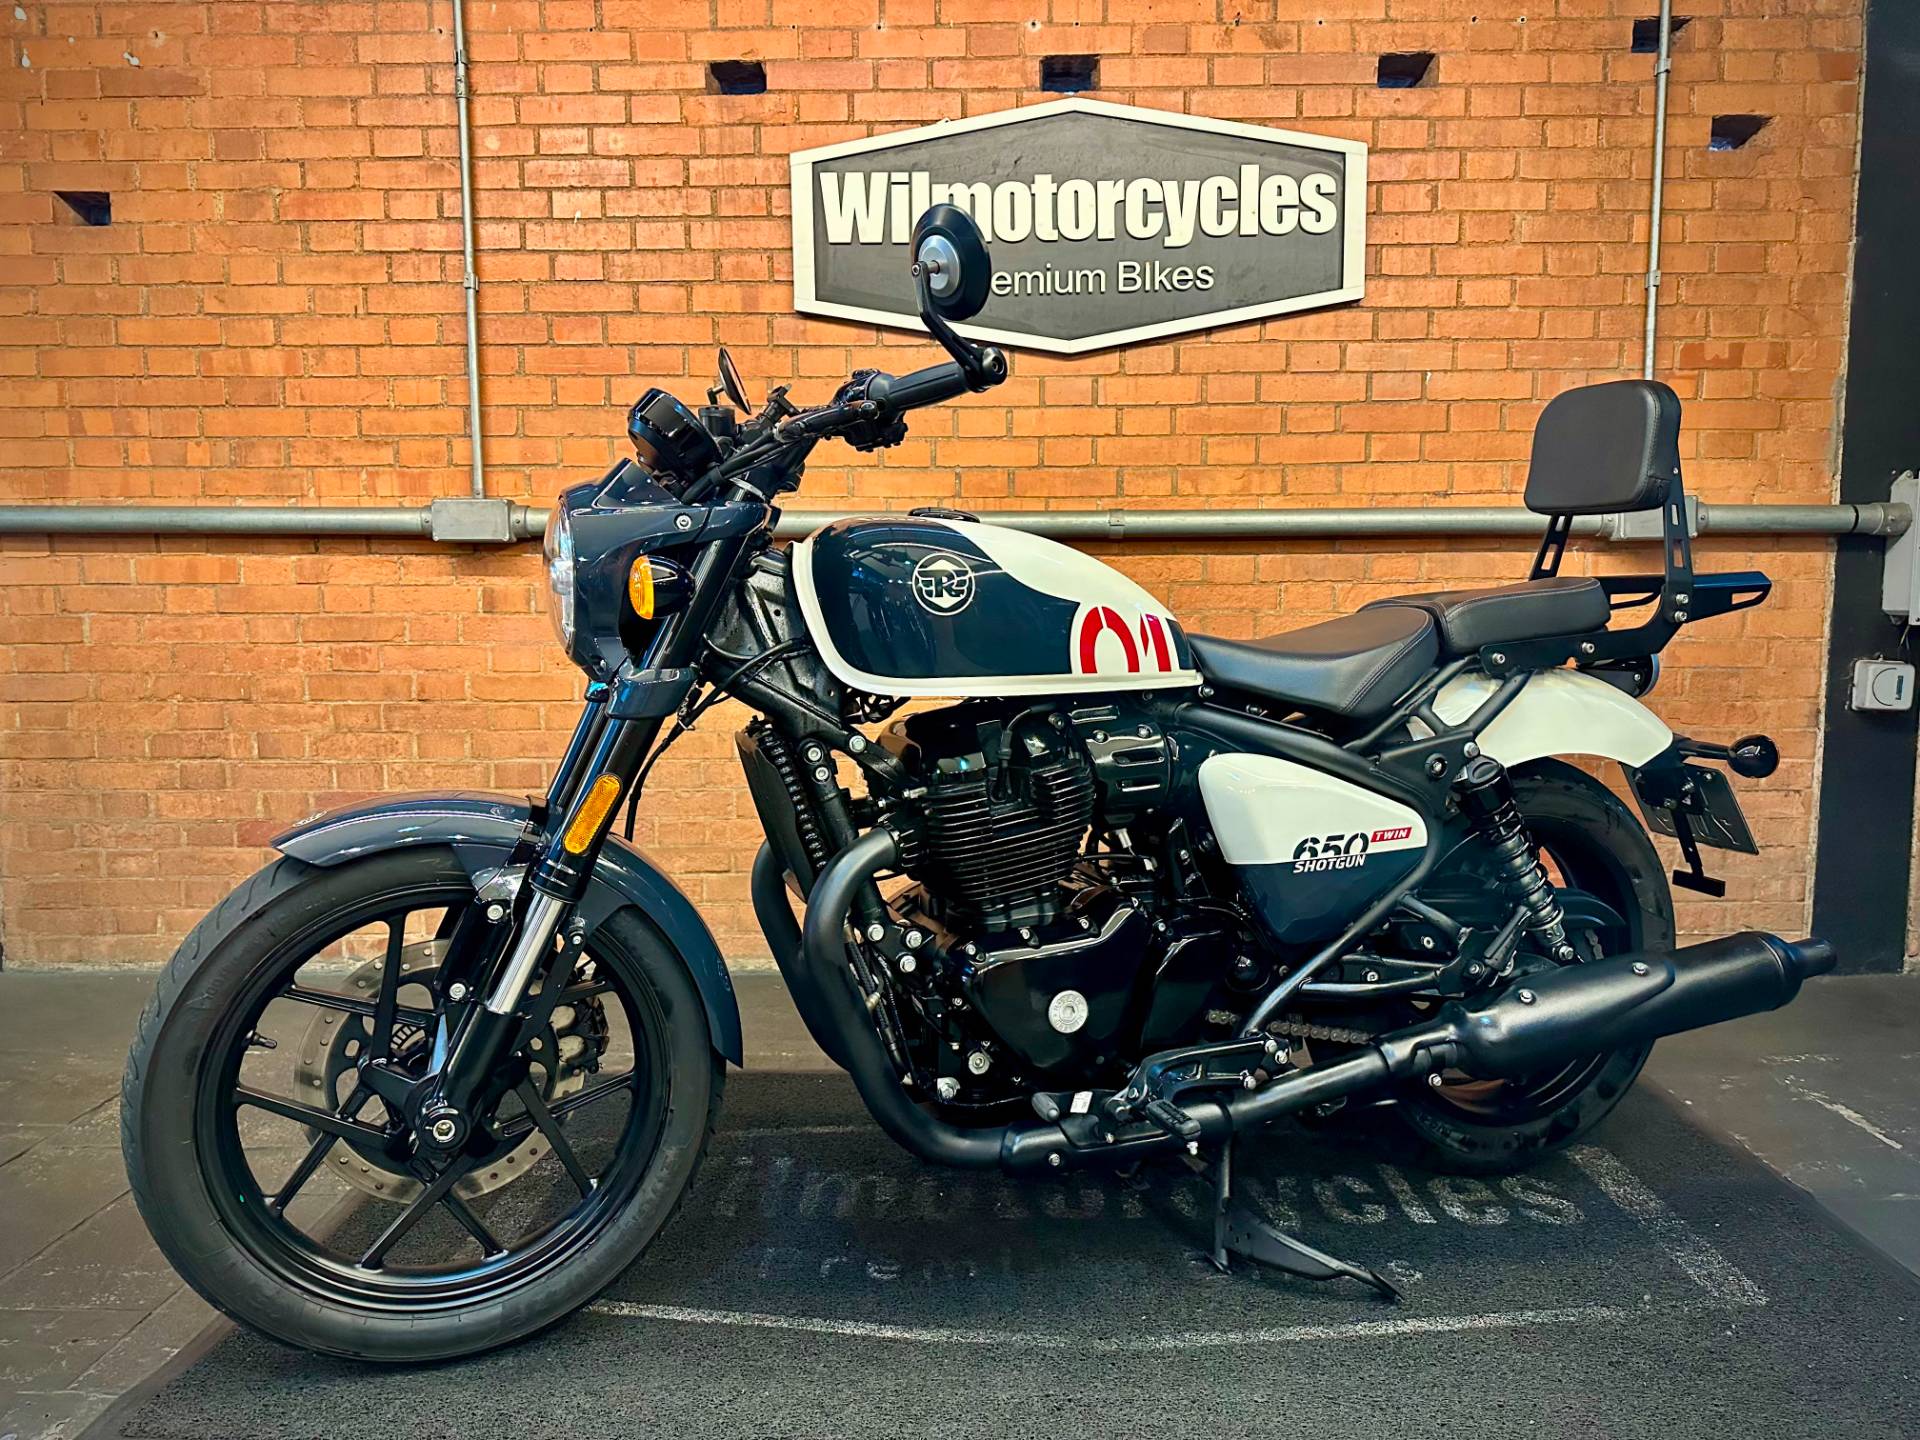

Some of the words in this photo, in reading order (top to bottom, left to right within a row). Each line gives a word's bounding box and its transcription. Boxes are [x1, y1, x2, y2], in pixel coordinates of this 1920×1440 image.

[819, 164, 1338, 249] Wilmotorcycles
[990, 262, 1107, 297] emium
[1292, 831, 1370, 861] 650
[1374, 828, 1410, 842] TWIN
[1292, 854, 1367, 874] SHOTGUN
